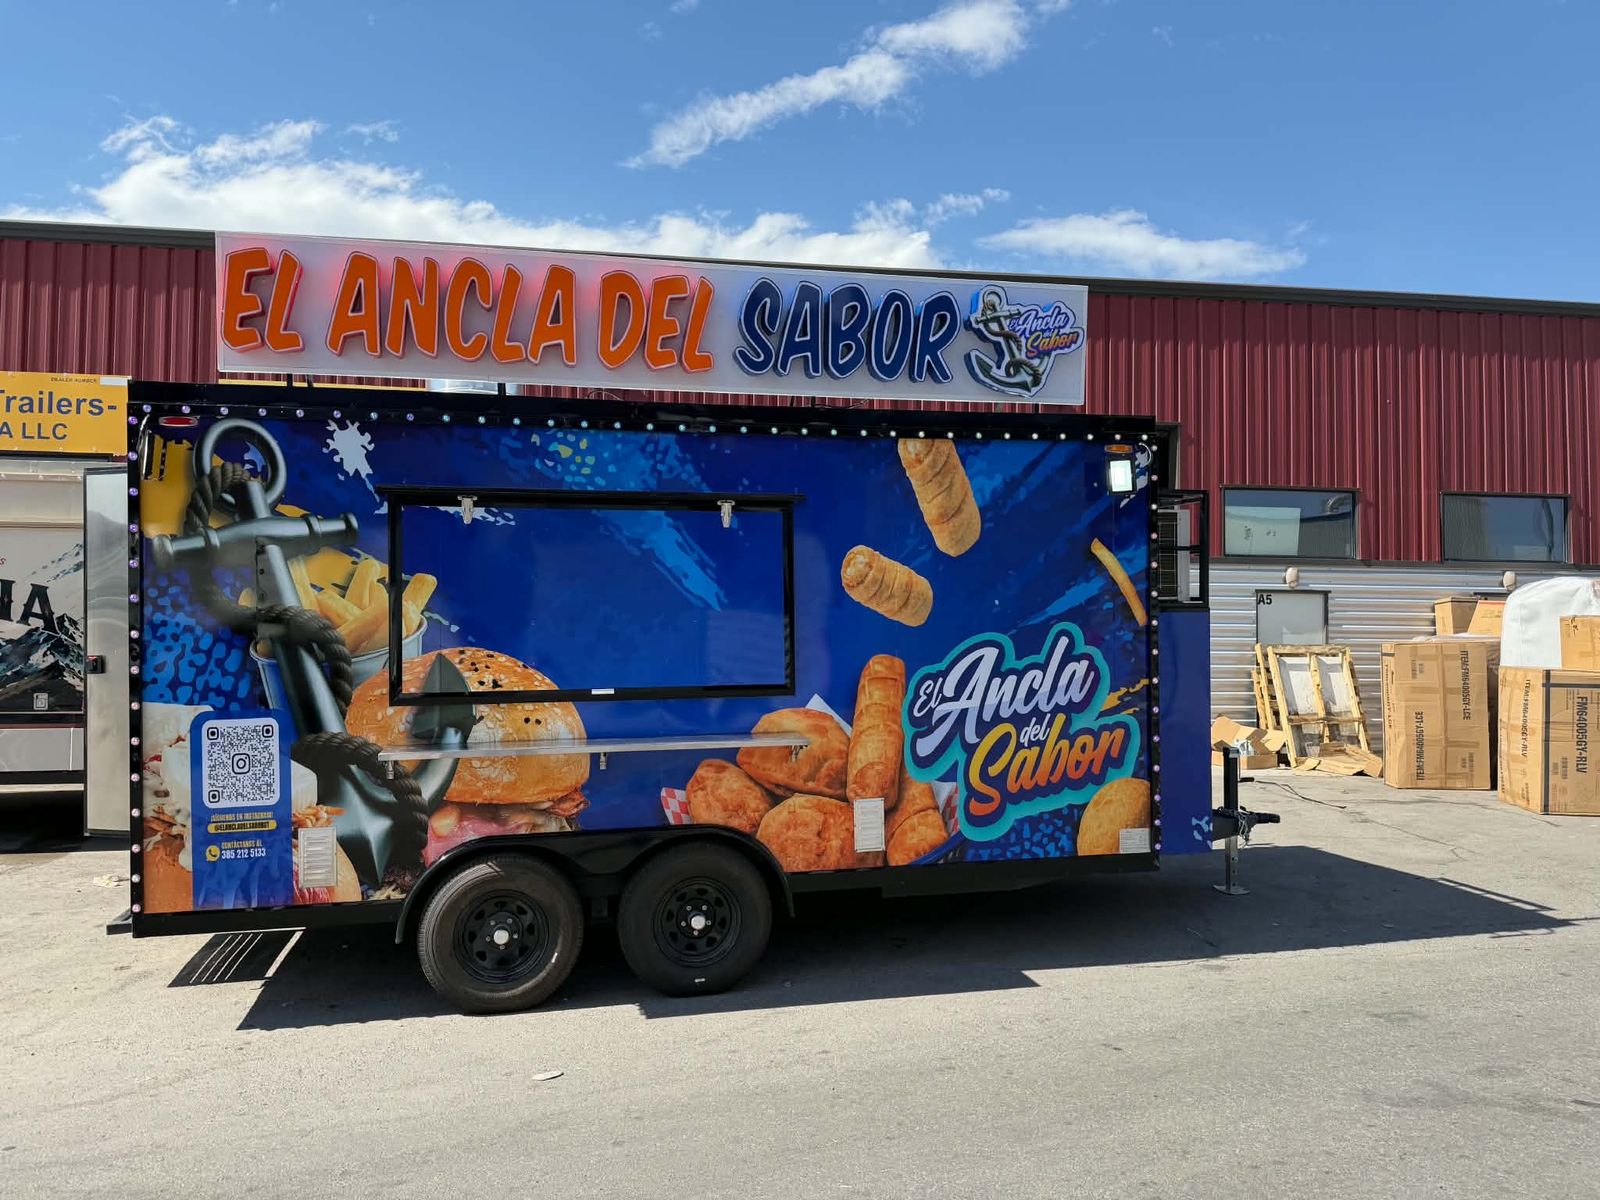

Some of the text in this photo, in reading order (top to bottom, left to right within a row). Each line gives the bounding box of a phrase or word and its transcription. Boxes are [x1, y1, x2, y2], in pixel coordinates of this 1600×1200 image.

[221, 247, 961, 384] EL ANCLA DEL SABOR
[1015, 305, 1068, 338] Ancla
[1027, 329, 1079, 357] Sabor
[0, 389, 118, 416] railers-
[22, 422, 68, 440] LLC
[1257, 593, 1273, 606] A5
[913, 635, 1095, 757] El Ancla
[1019, 713, 1051, 747] del
[1575, 696, 1588, 774] FM64005GY-RLV
[968, 712, 1125, 816] Sabor
[221, 848, 266, 859] 385 212 5133
